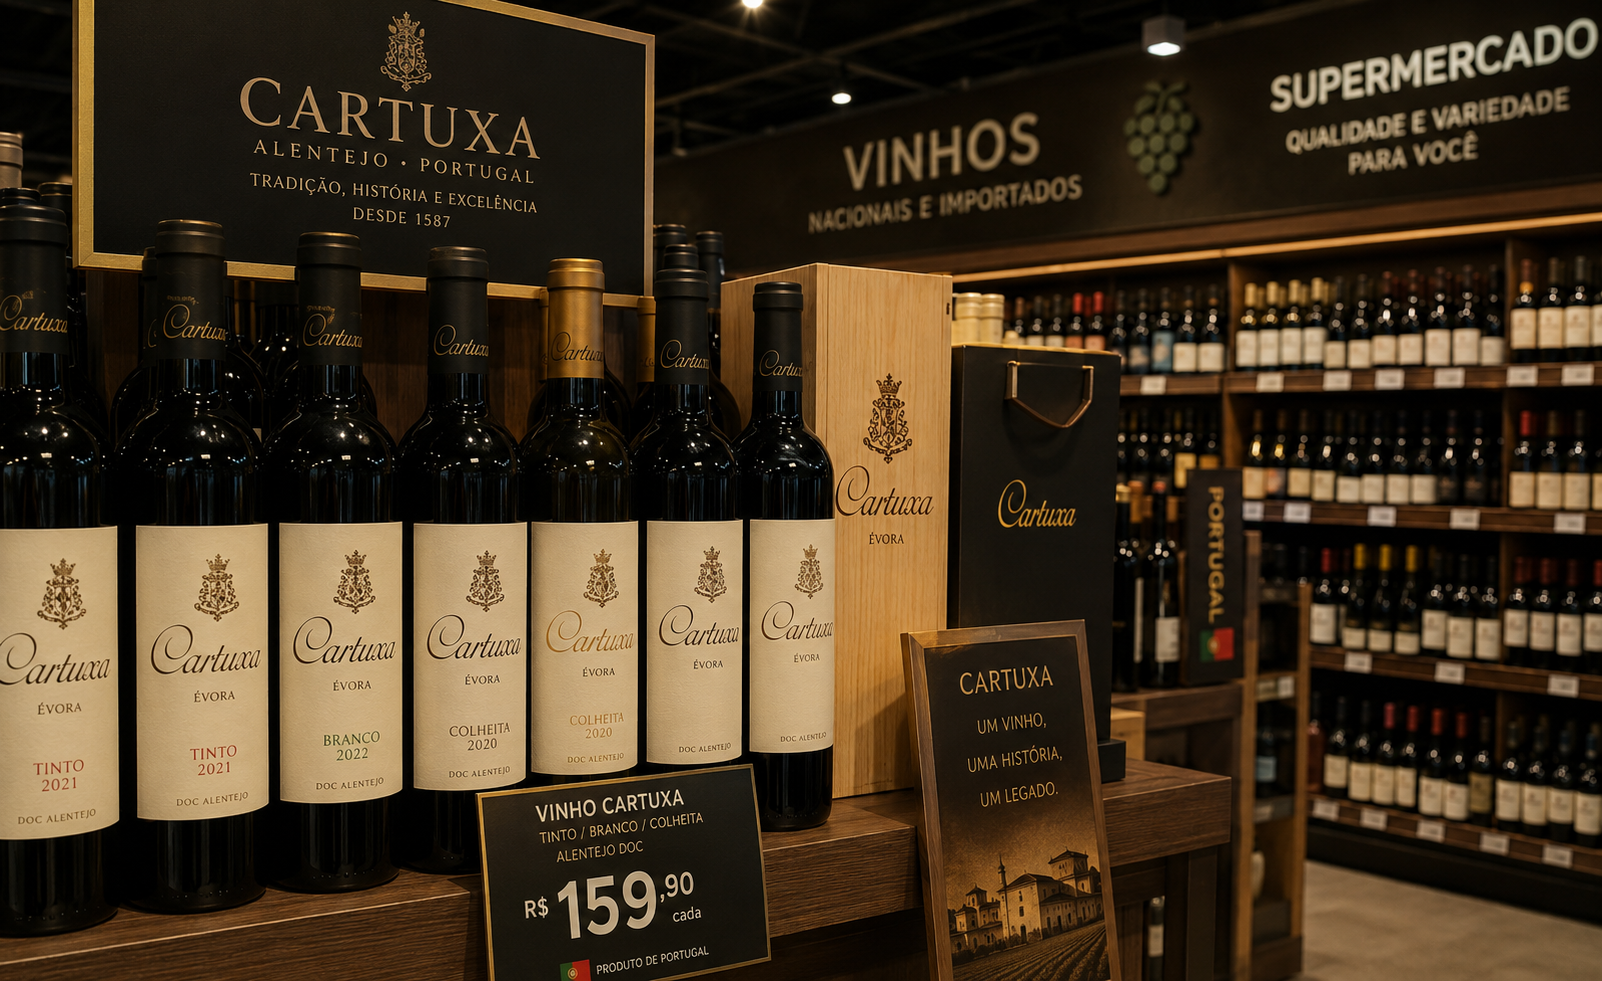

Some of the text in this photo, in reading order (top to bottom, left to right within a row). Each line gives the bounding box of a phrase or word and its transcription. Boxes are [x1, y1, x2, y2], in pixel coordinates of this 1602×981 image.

[1269, 16, 1600, 113] SUPERMERCADO
[239, 76, 541, 160] CARTUXA
[1285, 85, 1571, 155] QUALIDADE E VARIEDADE
[253, 139, 535, 184] ALENTEJO PORTUGAL
[843, 111, 1041, 192] VINHOS
[1347, 130, 1480, 176] PARA VOCÊ
[250, 170, 538, 214] TRADIÇÃO, HISTÓRIA E EXCELÊNCIA
[807, 173, 1083, 234] NACIONAIS E IMPORTADOS
[352, 206, 451, 229] DESDE 1587
[835, 465, 934, 517] Cartuxa
[998, 479, 1077, 529] Cartuxa
[868, 532, 905, 545] ÉVORA
[1207, 486, 1225, 624] PORTUGAL
[546, 609, 634, 655] Cartuxa
[658, 604, 740, 647] Cartuxa
[761, 601, 834, 642] Cartuxa
[293, 616, 396, 665] Cartuxa
[427, 614, 521, 660] Cartuxa
[0, 632, 111, 688] Cartuxa
[150, 624, 262, 676] Cartuxa
[793, 653, 820, 664] ÉVORA
[582, 666, 616, 678] ÉVORA
[693, 659, 724, 670] ÉVORA
[333, 679, 372, 692] ÉVORA
[464, 674, 501, 686] ÉVORA
[959, 665, 1053, 696] CARTUXA
[193, 690, 236, 704] ÉVORA
[37, 702, 82, 716] ÉVORA
[569, 712, 625, 727] COLHEITA
[449, 723, 511, 738] COLHEITA
[585, 726, 613, 740] 2020
[977, 712, 1046, 735] UM VINHO,
[323, 730, 381, 747] BRANCO
[467, 738, 498, 751] 2020
[679, 742, 732, 754] DOC ALENTEJO
[780, 731, 828, 743] DOC ALENTEJO
[190, 744, 238, 761] TINTO
[336, 747, 369, 761] 2022
[567, 752, 625, 764] DOC ALENTEJO
[967, 745, 1063, 774] UMA HISTÓRIA,
[33, 759, 85, 776] TINTO
[197, 761, 231, 777] 2021
[448, 765, 511, 779] DOC ALENTEJO
[41, 776, 78, 792] 2021
[315, 776, 384, 791] DOC ALENTEJO
[980, 781, 1059, 808] UM LEGADO.
[176, 791, 249, 806] DOC ALENTEJO
[535, 788, 685, 823] VINHO CARTUXA
[17, 808, 97, 825] DOC ALENTEJO
[539, 812, 704, 844] TINTO / BRANCO / COLHEITA
[556, 840, 644, 863] ALENTEJO DOC
[524, 896, 549, 919] R$
[672, 906, 702, 923] cada
[596, 945, 709, 976] PRODUTO DE PORTUGAL
